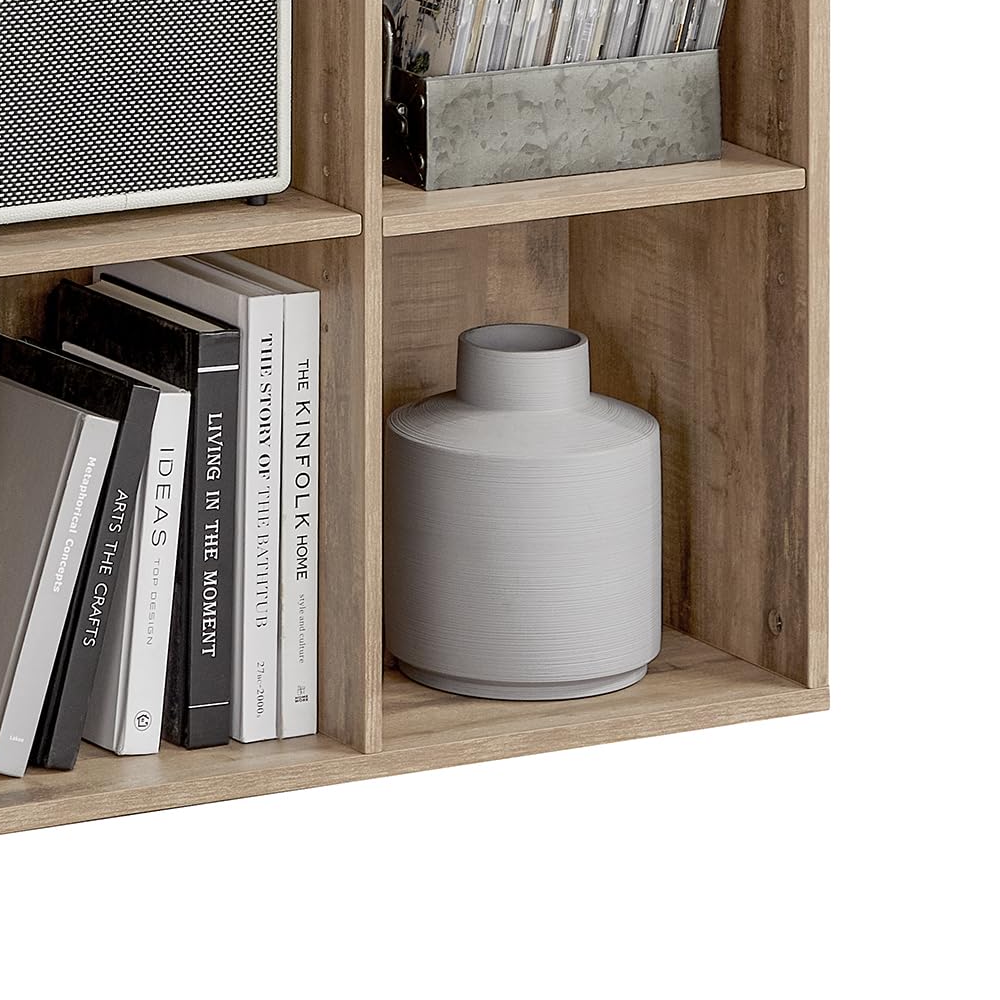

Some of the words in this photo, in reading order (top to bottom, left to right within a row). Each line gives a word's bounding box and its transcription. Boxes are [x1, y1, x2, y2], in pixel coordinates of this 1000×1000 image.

[260, 333, 273, 377] THE
[298, 359, 309, 391] THE
[259, 383, 272, 447] STORY
[207, 413, 223, 480] LIVING
[258, 454, 270, 480] OF
[295, 400, 310, 529] KINFOLK
[69, 456, 97, 533] Metaphorical
[109, 489, 129, 533] ARTS
[151, 448, 175, 547] IDEAS
[205, 490, 220, 510] IN
[258, 486, 270, 528] THE
[99, 541, 118, 575] THE
[204, 520, 219, 561] THE
[296, 534, 308, 580] HOME
[152, 558, 160, 586] TOP
[256, 533, 269, 628] BATHTUB
[83, 582, 108, 647] CRAFTS
[146, 591, 157, 645] DESIGN
[202, 570, 218, 657] MOMENT
